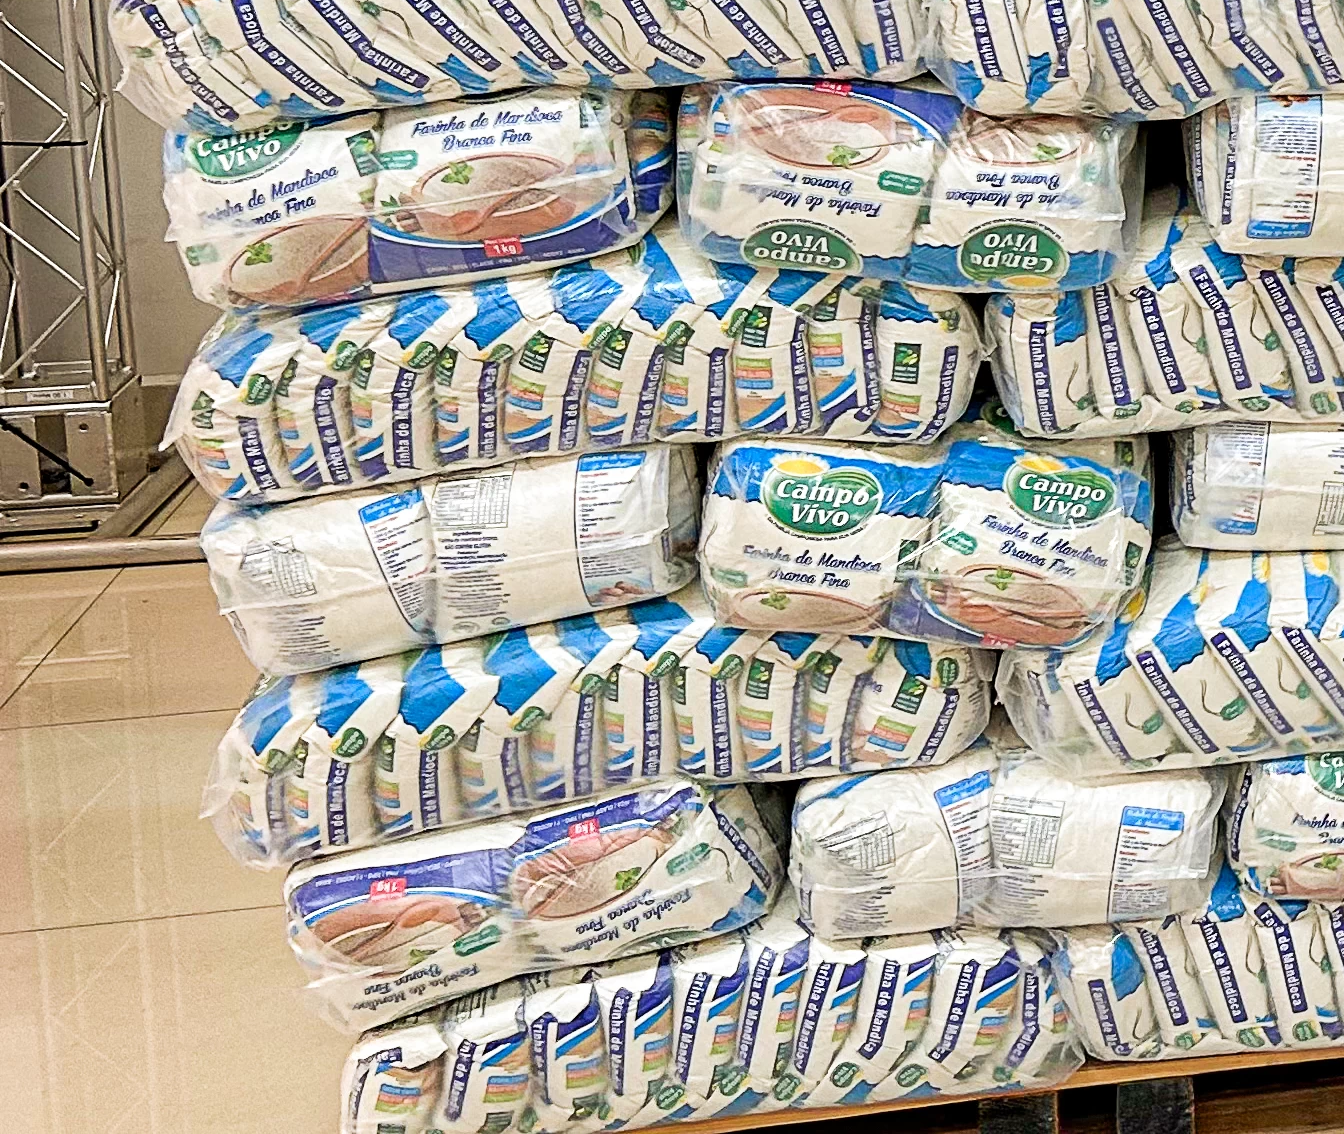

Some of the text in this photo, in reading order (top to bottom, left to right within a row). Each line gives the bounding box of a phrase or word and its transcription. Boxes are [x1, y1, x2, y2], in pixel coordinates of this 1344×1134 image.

[411, 107, 563, 139] Farinha de Mandioca
[216, 137, 281, 173] Vivo
[443, 130, 532, 153] Branca Fina
[248, 165, 339, 208] de Mandioca
[1012, 170, 1060, 189] Branca
[770, 229, 829, 253] Vivo
[983, 231, 1040, 253] Vivo
[753, 245, 849, 272] Campo
[969, 249, 1055, 274] Campo
[1153, 331, 1179, 388] Mandioca
[1220, 326, 1245, 384] Mandioca
[1291, 327, 1318, 378] Mandioca
[1103, 343, 1127, 400] Mandioca
[776, 478, 870, 506] Campo
[1019, 472, 1106, 503] Campo
[791, 501, 851, 526] Vivo
[1032, 495, 1088, 520] Vivo
[982, 514, 1109, 568] Farinha de Mandioca
[1001, 539, 1046, 569] Branca
[742, 545, 882, 573] Farinha de Mandioca
[821, 572, 851, 588] Fina
[1285, 627, 1317, 670] Farinha
[1218, 638, 1286, 732] Farinha Mandioca
[1141, 657, 1211, 751] Farinha Mandioca
[1218, 963, 1242, 1019] Mandioca
[1282, 954, 1302, 1008] Mandioca
